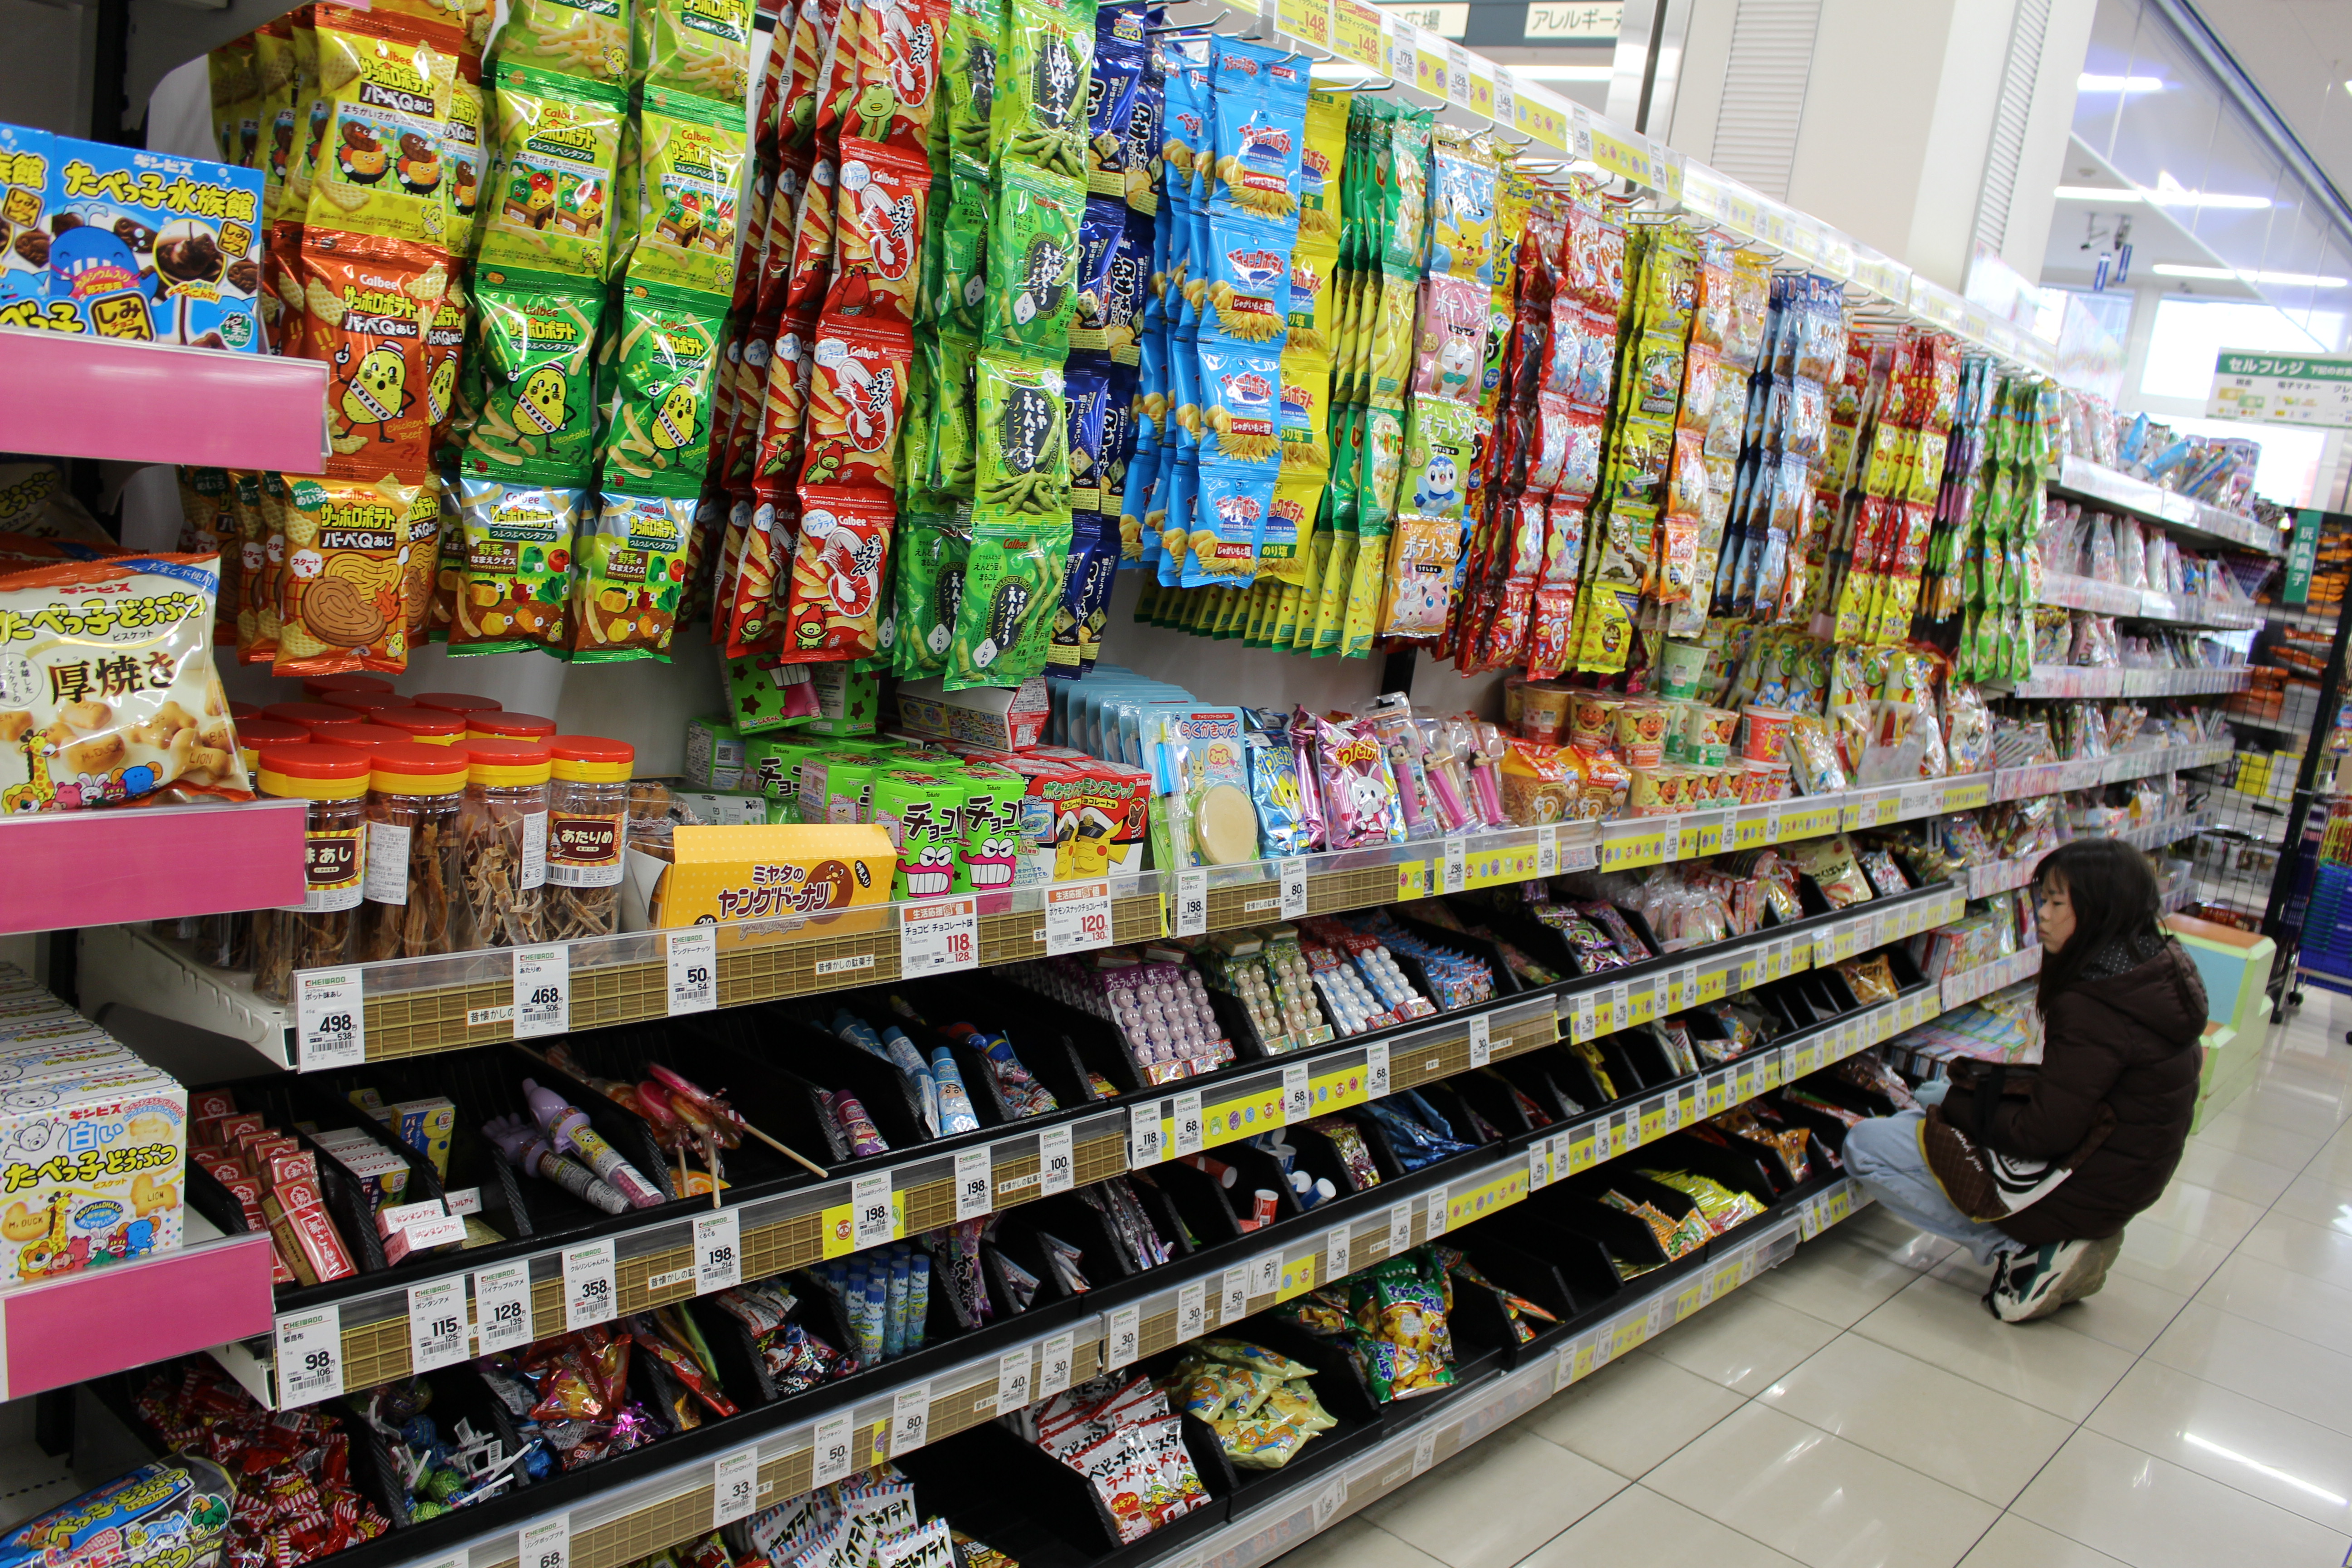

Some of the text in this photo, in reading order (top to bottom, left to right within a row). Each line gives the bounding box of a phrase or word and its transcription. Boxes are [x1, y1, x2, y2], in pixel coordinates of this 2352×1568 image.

[1305, 11, 1325, 34] 148
[1359, 34, 1378, 55] 148
[359, 56, 434, 95] サッポロポテト
[343, 104, 400, 124] まちがいさがし
[528, 118, 597, 152] サッポロポテト
[681, 129, 712, 144] Calbee
[514, 152, 562, 169] まちがいさがし
[670, 140, 728, 169] サッポロポテト
[134, 154, 194, 176] ギンビス
[872, 170, 900, 186] Calbee
[63, 160, 256, 222] たべっ子水族館
[359, 274, 397, 290] Calbee
[343, 285, 417, 319] サッポロポテト
[1234, 297, 1274, 315] じゃがいもと塩
[1435, 295, 1490, 323] ポテト丸
[97, 299, 142, 320] しみ
[523, 304, 559, 318] Calbee
[111, 319, 135, 330] チョコ
[507, 318, 578, 341] サッポロポテト
[661, 319, 688, 333] Calbee
[850, 346, 879, 359] Calbee
[2228, 356, 2305, 376] セルフレジ
[351, 382, 389, 420] POTATO
[520, 399, 554, 434] POTATO
[1035, 398, 1048, 430] さや
[401, 429, 424, 441] Beef
[660, 411, 685, 446] POTATO
[1023, 391, 1037, 469] えんどう
[1232, 420, 1273, 436] じゃがいもと塩
[1419, 414, 1476, 442] ポテト丸
[296, 493, 326, 506] めいろ
[338, 490, 378, 502] Calbee
[639, 502, 664, 515] Calbee
[320, 506, 397, 529] サッポロポテト
[490, 505, 557, 529] サッポロポテト
[838, 515, 867, 527] Calbee
[629, 514, 677, 541] サッポロポテト
[806, 520, 835, 532] ノンフライ
[478, 543, 511, 555] 野菜の
[1003, 538, 1029, 549] Calbee
[1403, 535, 1457, 561] ポテト丸
[617, 550, 643, 564] 野菜の
[1216, 544, 1252, 558] じゃがいもと塩
[1262, 545, 1289, 557] のり塩
[292, 555, 321, 567] スタート
[470, 554, 517, 567] なまえクイズ
[147, 562, 214, 588] たまご不使用
[609, 561, 646, 575] なまえクイズ
[979, 573, 997, 581] まるごと
[59, 582, 133, 595] ギンビス
[1016, 590, 1028, 616] さや
[0, 592, 207, 644] たべっ子どうぶつ
[1002, 586, 1018, 647] えんどう
[113, 629, 154, 642] ビスケット
[47, 651, 177, 706] 厚焼き
[1180, 720, 1240, 740] らくがきッズ
[189, 752, 213, 765] LION
[1136, 778, 1152, 788] Tohato
[561, 829, 613, 845] あたりめ
[752, 863, 807, 885] ミヤタの
[1291, 883, 1302, 895] 80
[717, 880, 831, 919] ヤングドーナツ
[1245, 898, 1280, 912] 昔懐かしの駄菓子
[1049, 900, 1108, 916] ポケモンスナックチョコレート味
[905, 919, 974, 936] チョコビ チョコレート味
[677, 934, 704, 943] HEIWADO
[525, 952, 555, 961] HEIWADO
[671, 945, 711, 956] ヤングドーナッツ
[817, 956, 872, 973] 昔懐かしの駄菓子
[312, 976, 346, 989] HEIWADO
[470, 1008, 514, 1024] 昔懐かしの
[1376, 1068, 1386, 1079] 68
[1294, 1090, 1305, 1102] 68
[69, 1103, 123, 1121] ギンビス
[1185, 1120, 1197, 1133] 68
[68, 1121, 124, 1153] 白い
[1143, 1132, 1157, 1146] 118
[3, 1143, 178, 1194] たべっ子どうぶつ
[93, 1178, 127, 1190] ビスケット
[147, 1192, 164, 1203] LION
[703, 1216, 727, 1228] HEIWADO
[699, 1230, 716, 1240] くるくる
[575, 1248, 601, 1259] HEIWADO
[486, 1269, 515, 1281] HEIWADO
[420, 1284, 451, 1297] HEIWADO
[1232, 1291, 1243, 1302] 50
[290, 1314, 323, 1328] HEIWADO
[1122, 1333, 1133, 1346] 30
[1054, 1361, 1067, 1374] 30
[1011, 1376, 1025, 1389] 40
[907, 1416, 921, 1430] 80
[529, 1523, 556, 1536] HEIWADO
